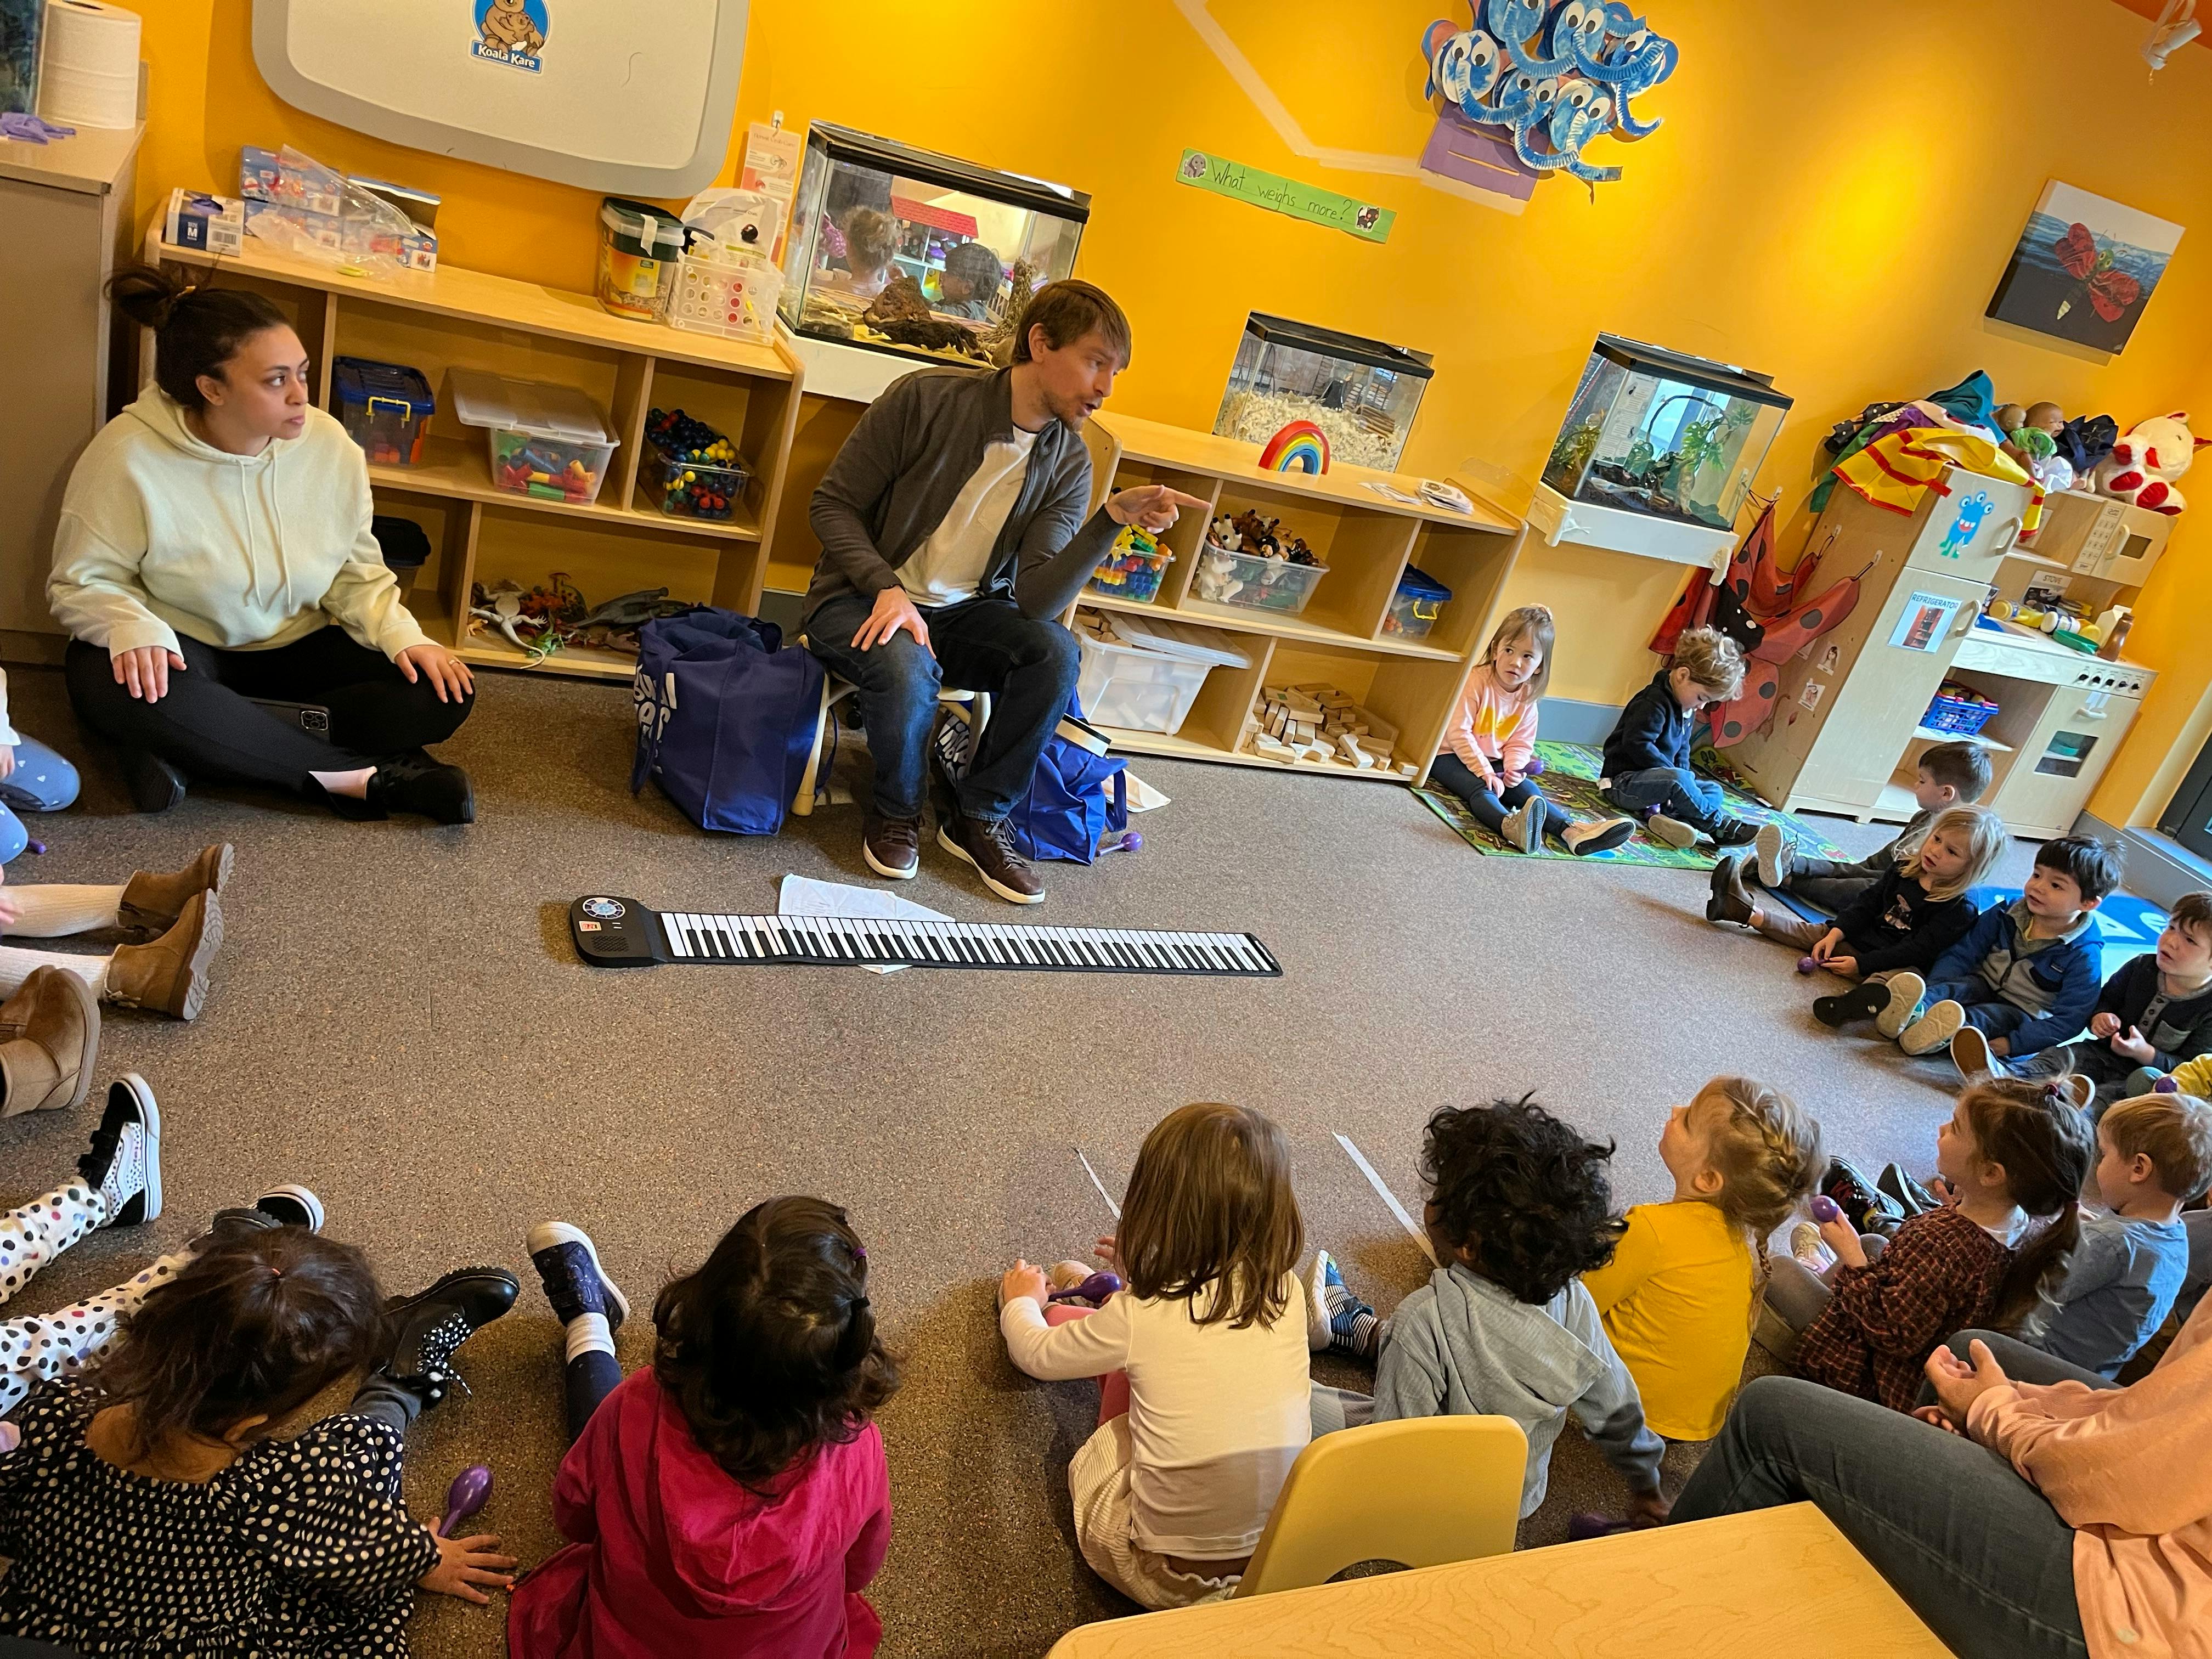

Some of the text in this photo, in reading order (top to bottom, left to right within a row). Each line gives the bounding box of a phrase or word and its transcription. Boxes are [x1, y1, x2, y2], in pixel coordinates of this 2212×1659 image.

[478, 44, 535, 67] Koala Kare
[1210, 158, 1353, 221] What weighs more?
[187, 227, 198, 238] M
[2042, 574, 2063, 584] STOVE
[1911, 594, 1959, 610] REFRIGERATOR
